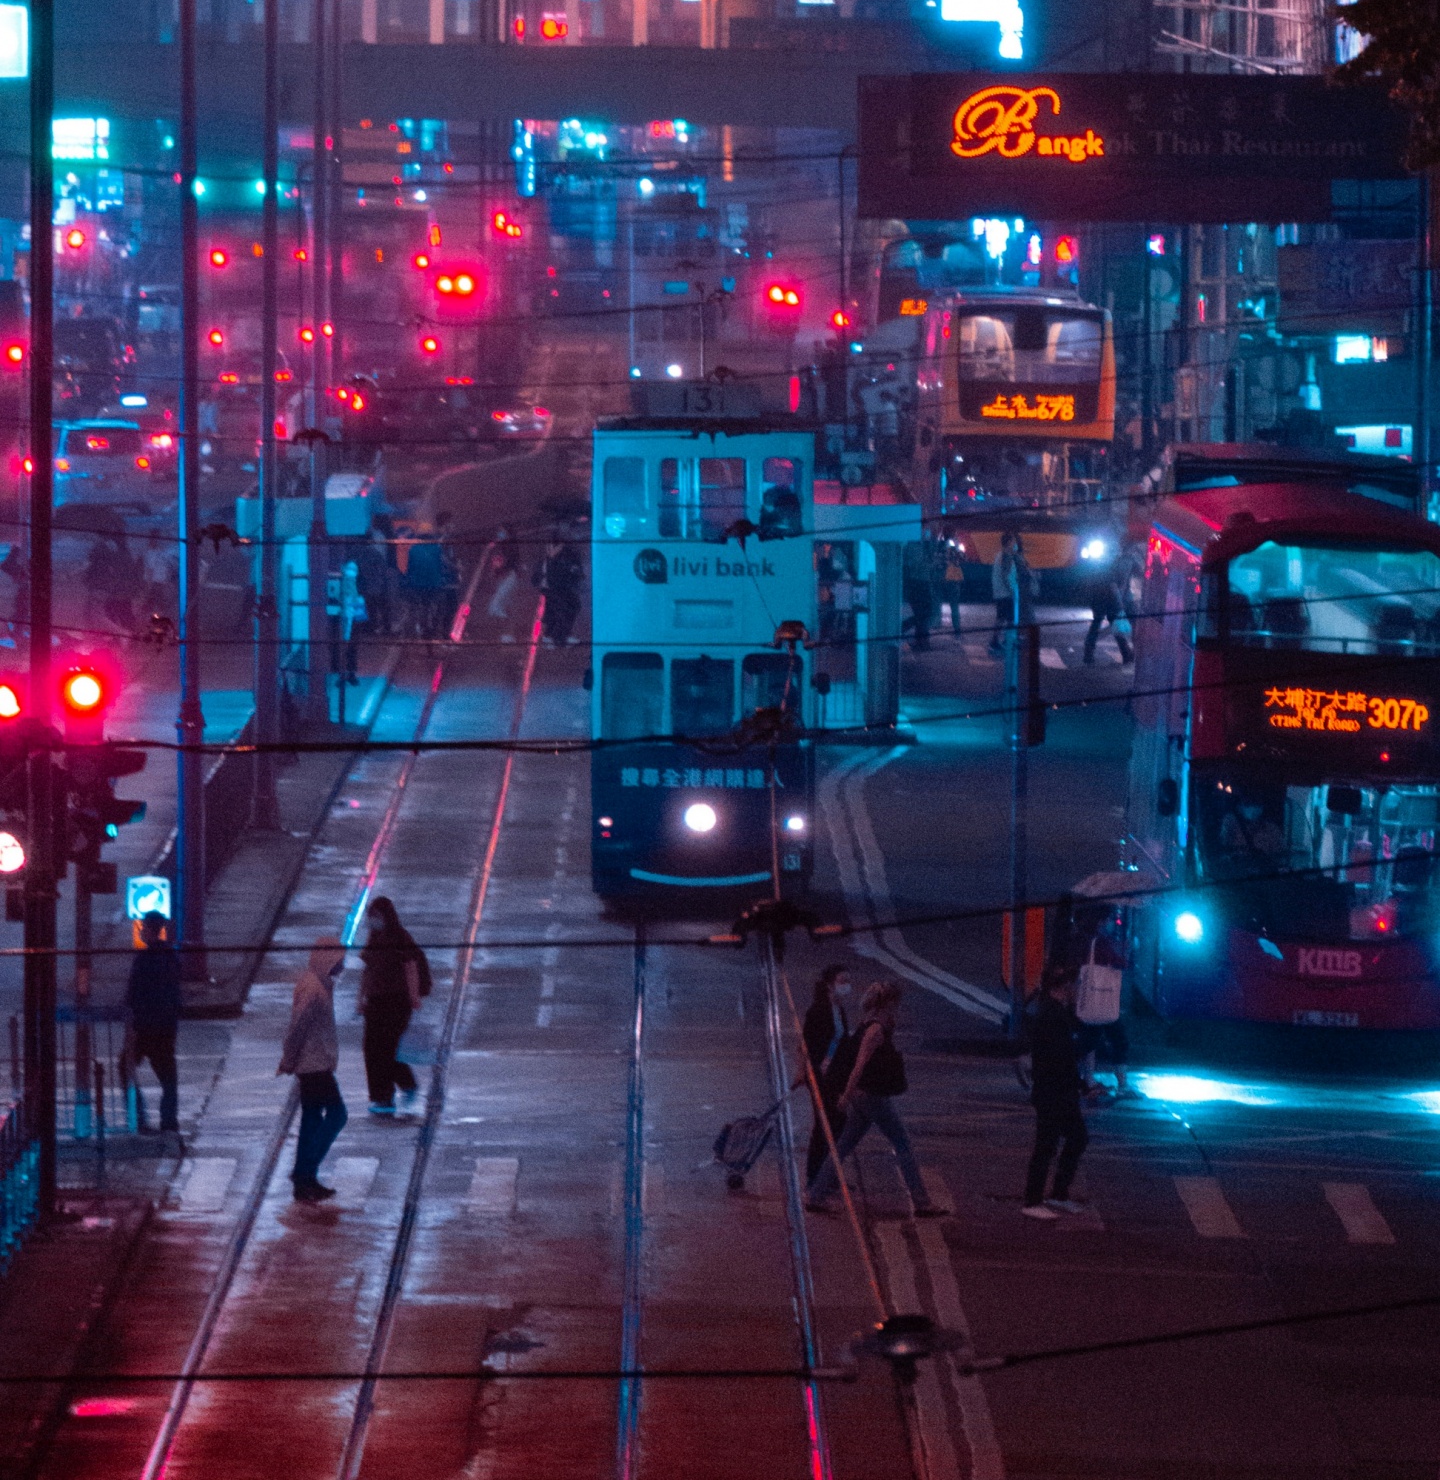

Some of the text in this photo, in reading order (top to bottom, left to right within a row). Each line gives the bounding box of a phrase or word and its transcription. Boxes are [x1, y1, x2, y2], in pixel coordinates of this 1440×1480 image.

[1037, 400, 1075, 421] 678
[673, 556, 775, 576] livi bank
[1368, 696, 1429, 730] 307P
[1297, 947, 1362, 977] KMB
